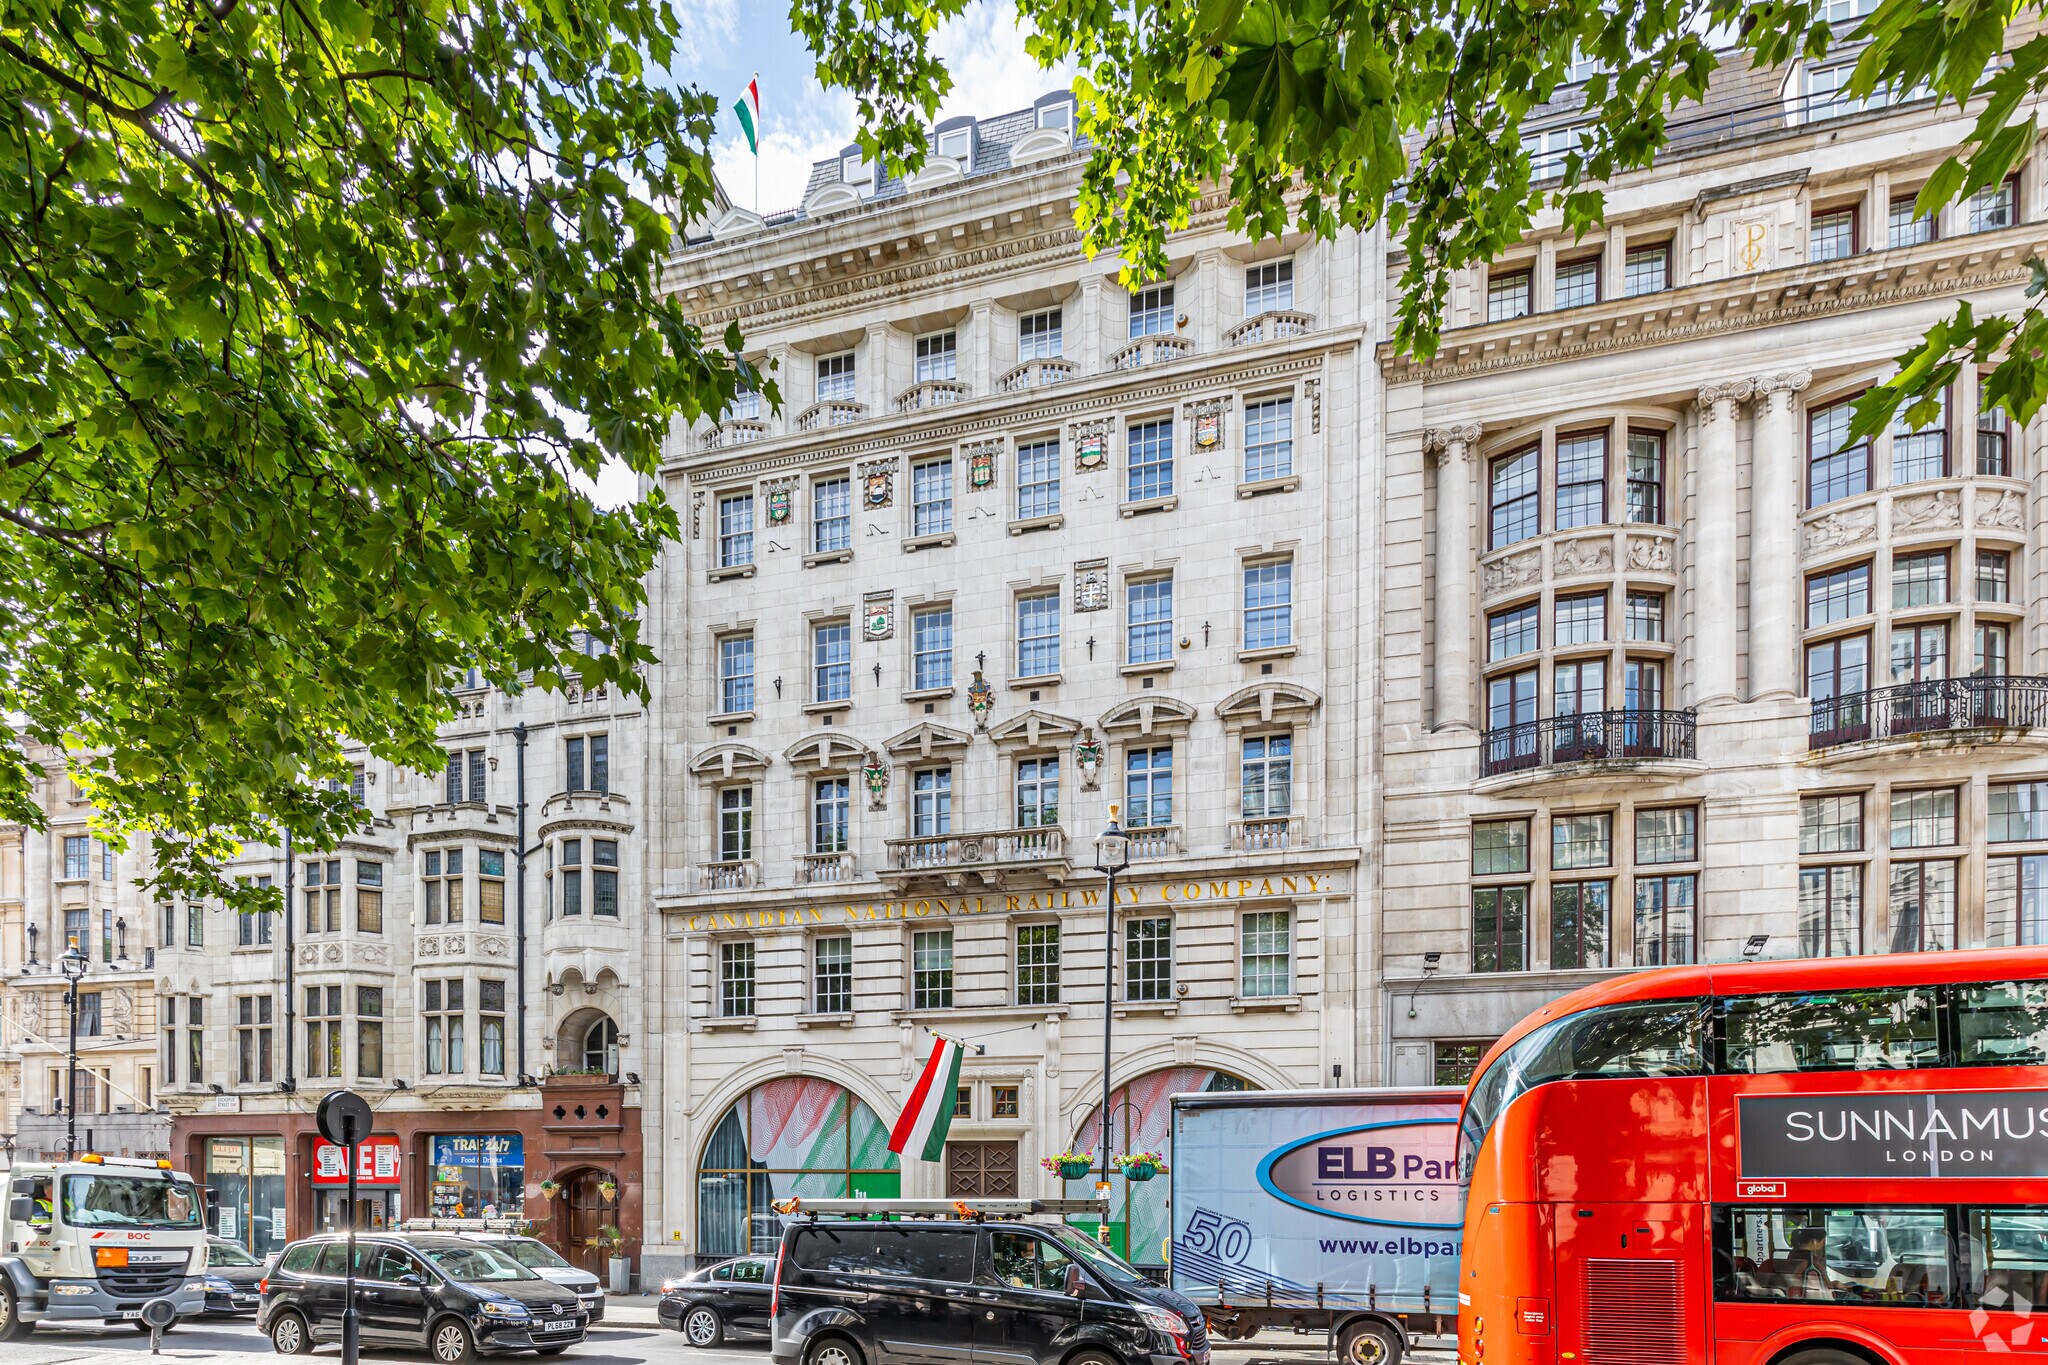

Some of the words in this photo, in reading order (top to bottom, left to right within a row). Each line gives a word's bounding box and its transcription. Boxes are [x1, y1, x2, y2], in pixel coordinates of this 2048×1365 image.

[845, 897, 989, 921] NATIONAL
[485, 1139, 510, 1152] 24/7
[483, 1156, 502, 1164] Drinks
[1886, 1150, 1994, 1163] LONDON
[1318, 1147, 1397, 1179] ELB
[628, 1171, 638, 1179] 20
[1747, 1184, 1776, 1195] global
[1317, 1190, 1439, 1201] LOGISTICS
[127, 1232, 151, 1240] BOC
[674, 1231, 681, 1239] H
[1183, 1210, 1253, 1263] 50
